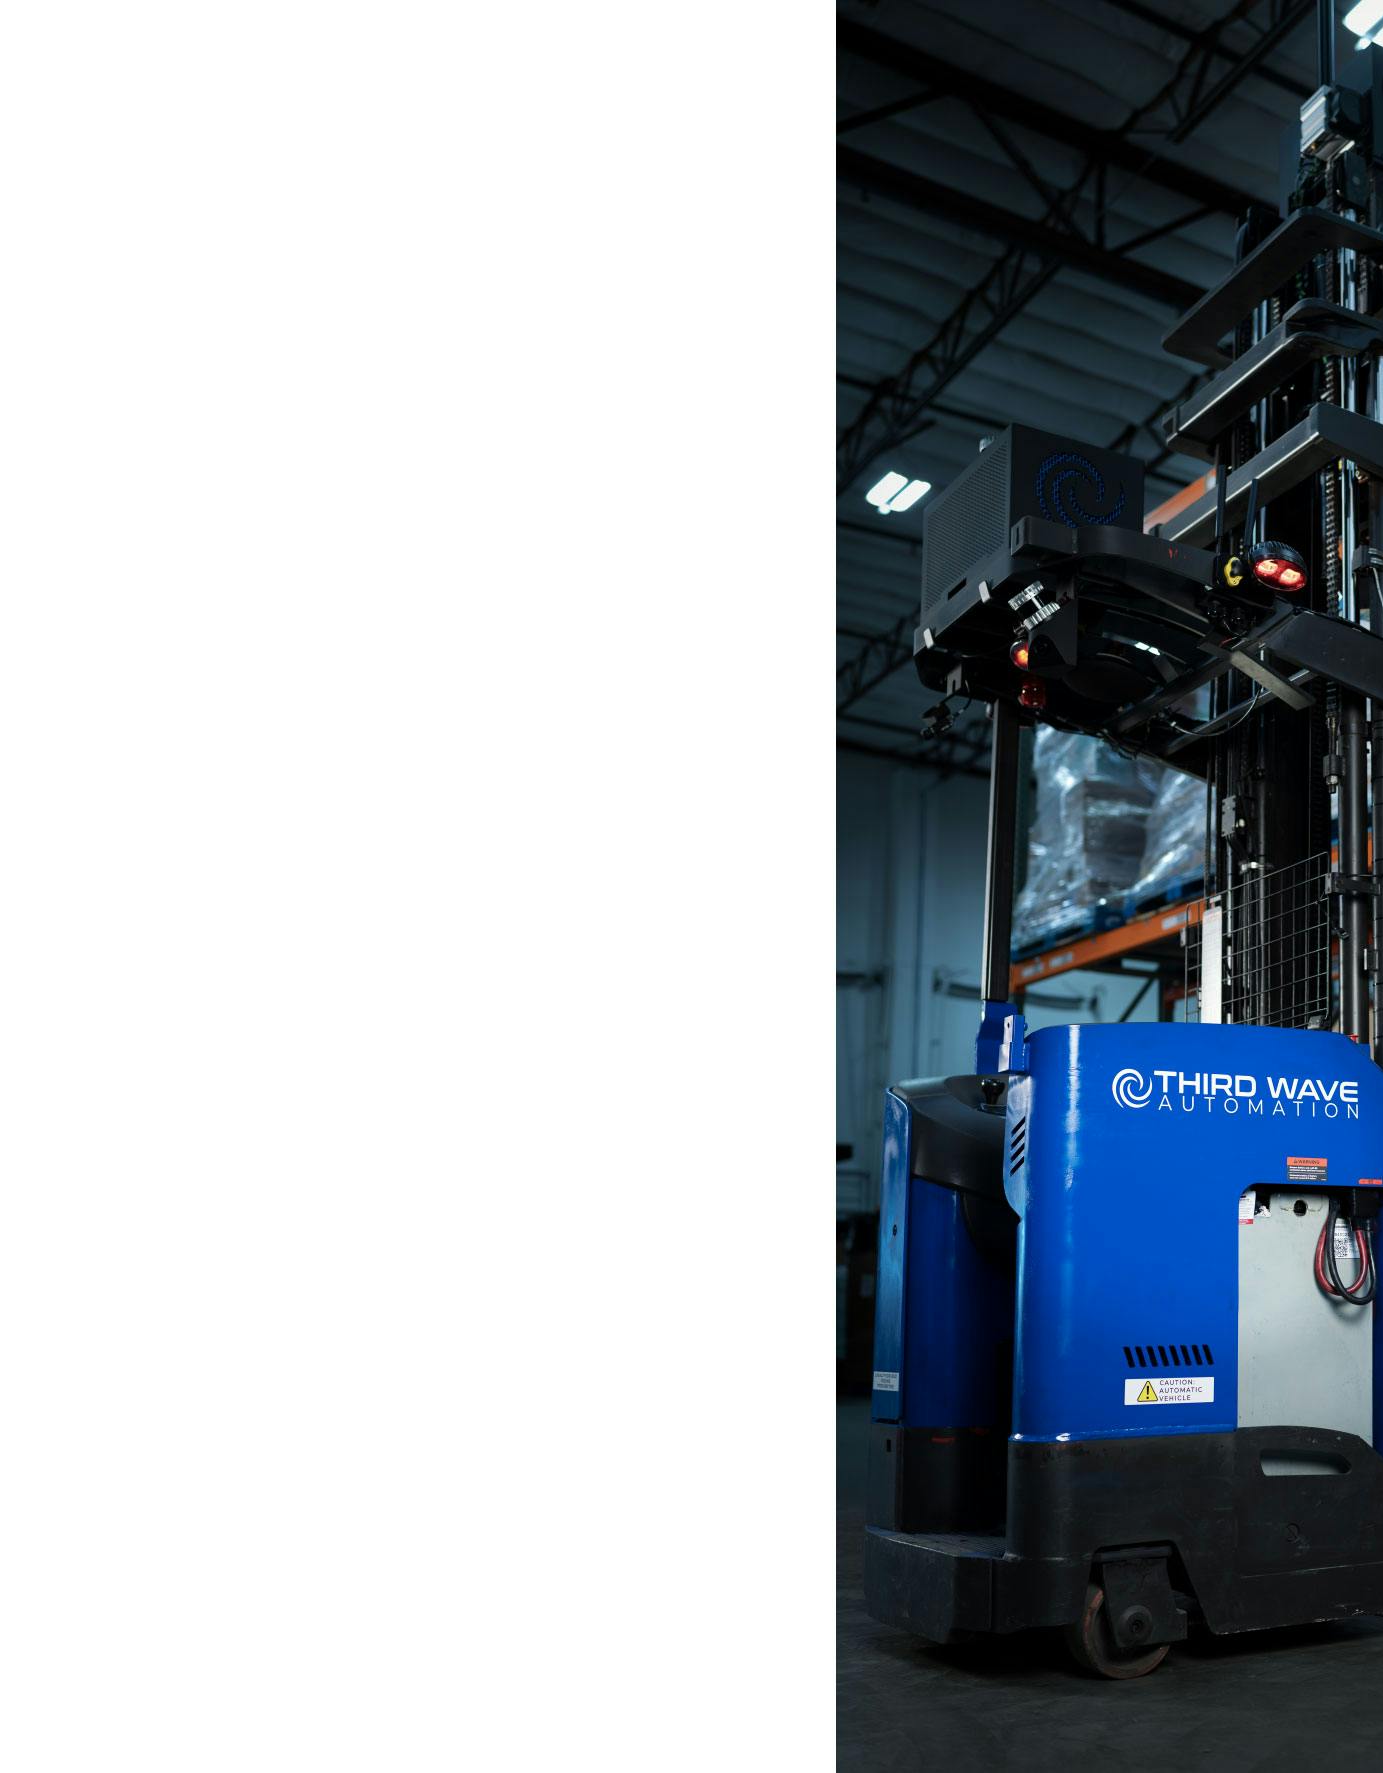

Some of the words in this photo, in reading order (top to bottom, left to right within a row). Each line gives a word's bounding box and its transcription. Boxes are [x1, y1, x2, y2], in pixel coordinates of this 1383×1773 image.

[1153, 1070, 1257, 1098] THIRD
[1266, 1076, 1359, 1103] WAVE
[1157, 1094, 1360, 1120] AUTOMATION
